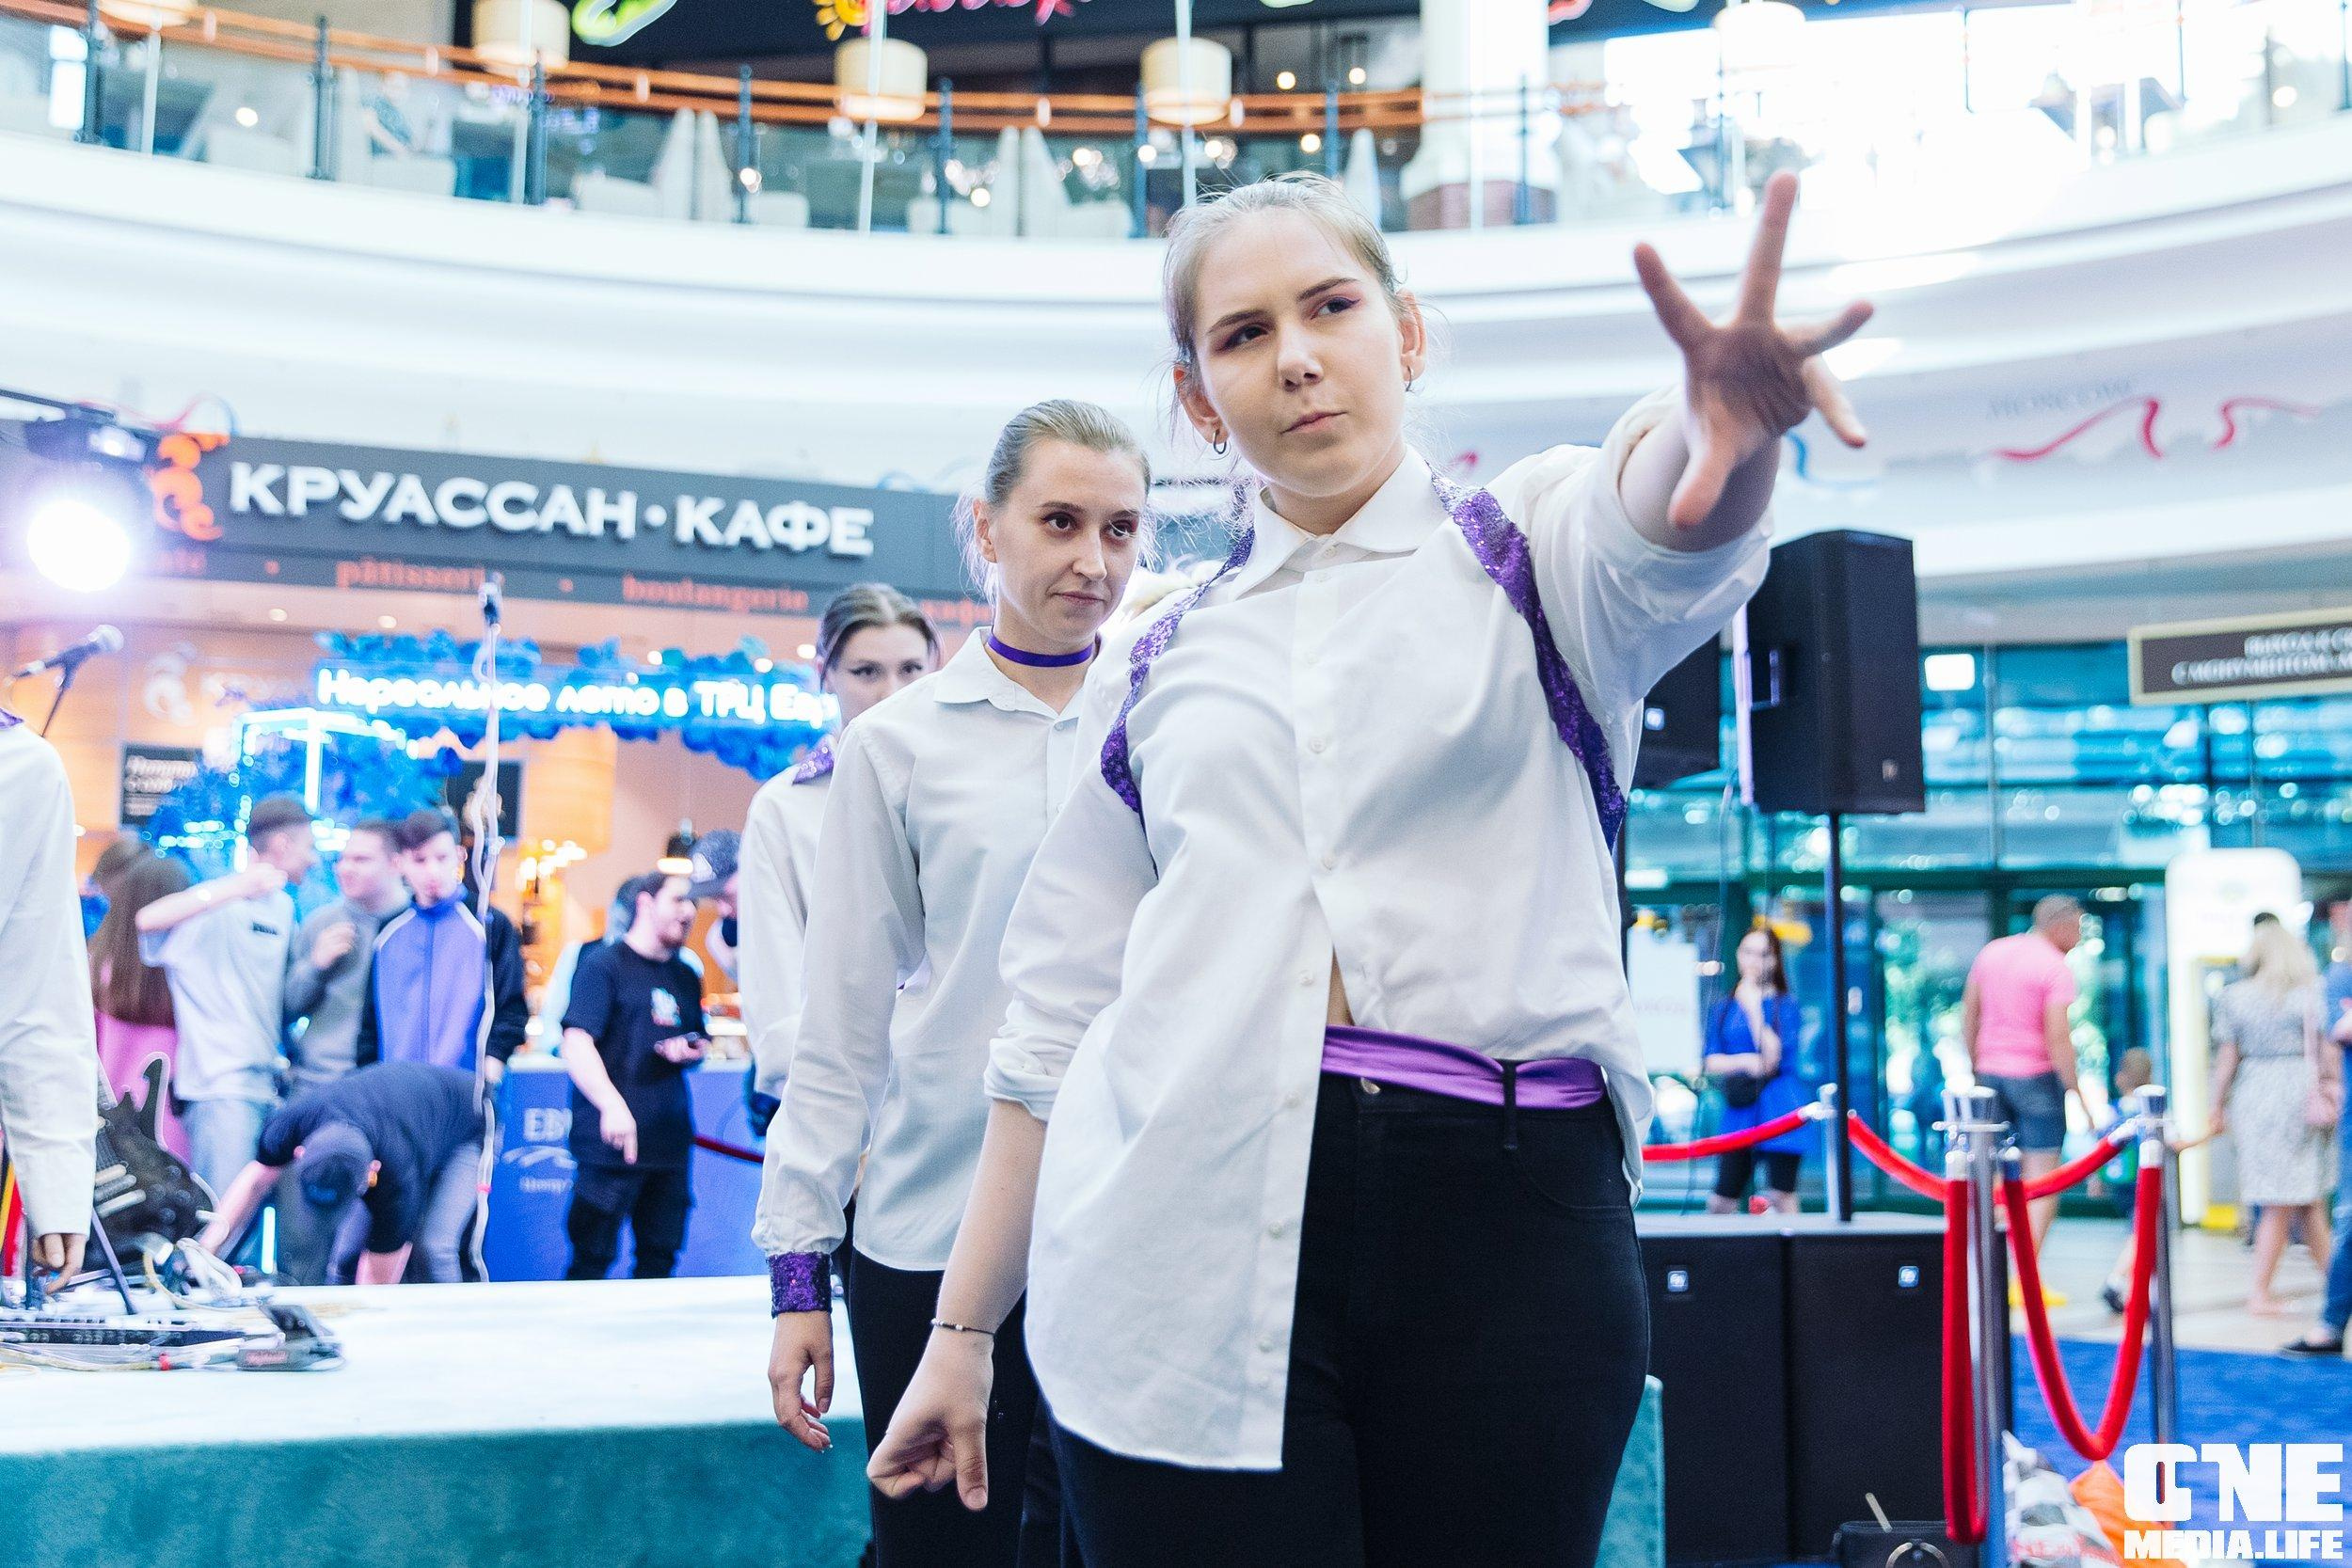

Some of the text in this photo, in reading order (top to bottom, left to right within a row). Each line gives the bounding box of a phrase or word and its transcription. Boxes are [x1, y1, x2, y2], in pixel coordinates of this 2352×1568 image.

[230, 461, 874, 556] КРУАССАН КАФЕ
[318, 668, 551, 714] Нереальное
[555, 684, 660, 716] лето
[692, 680, 766, 724] ТРЦ
